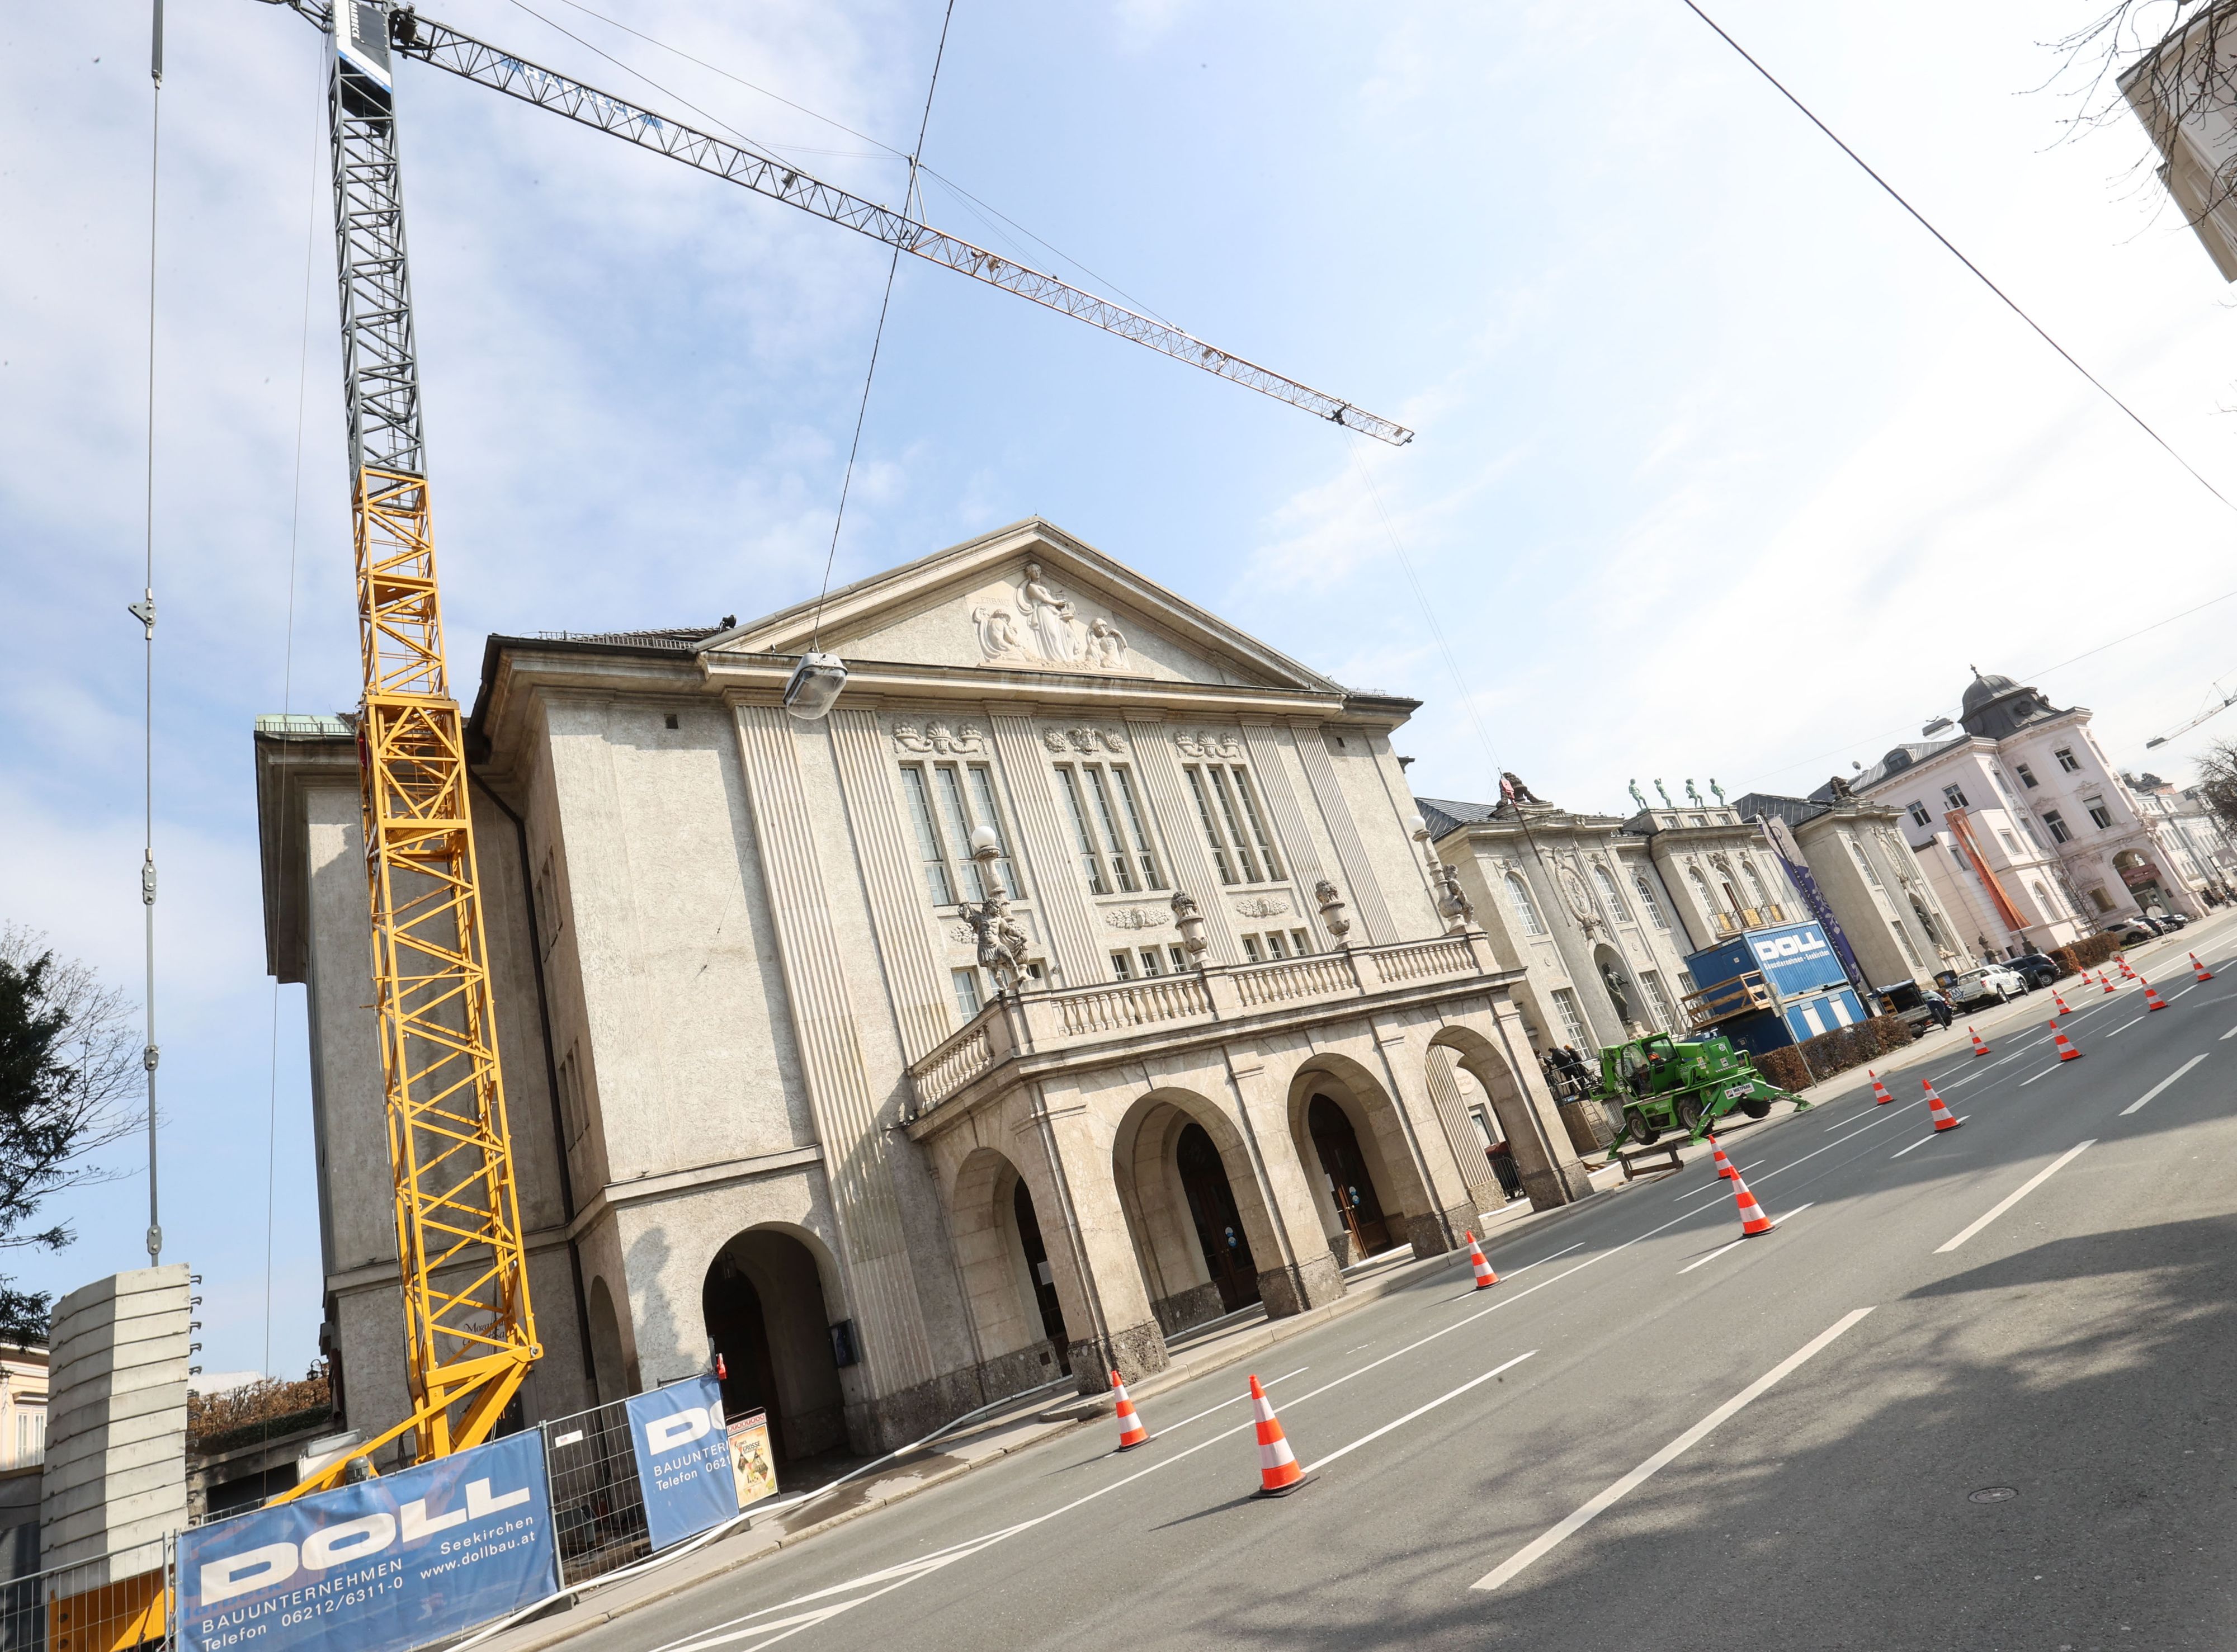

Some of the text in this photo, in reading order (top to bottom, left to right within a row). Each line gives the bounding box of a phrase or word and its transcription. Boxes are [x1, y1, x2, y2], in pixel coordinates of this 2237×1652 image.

[349, 1, 360, 39] HARBECK
[523, 64, 643, 120] HARBECK
[1754, 932, 1826, 961] DOLL
[1763, 956, 1804, 970] Bauunternehmen
[1805, 950, 1830, 960] Seekirchen
[656, 1470, 697, 1491] Telefon
[200, 1478, 530, 1606] DOLL
[421, 1531, 535, 1580] www.dollbau.at
[441, 1517, 533, 1555] Seekirchen
[202, 1558, 402, 1634] BAUUNTERNEHMEN
[202, 1577, 403, 1652] Telefon 06212/6311-0
